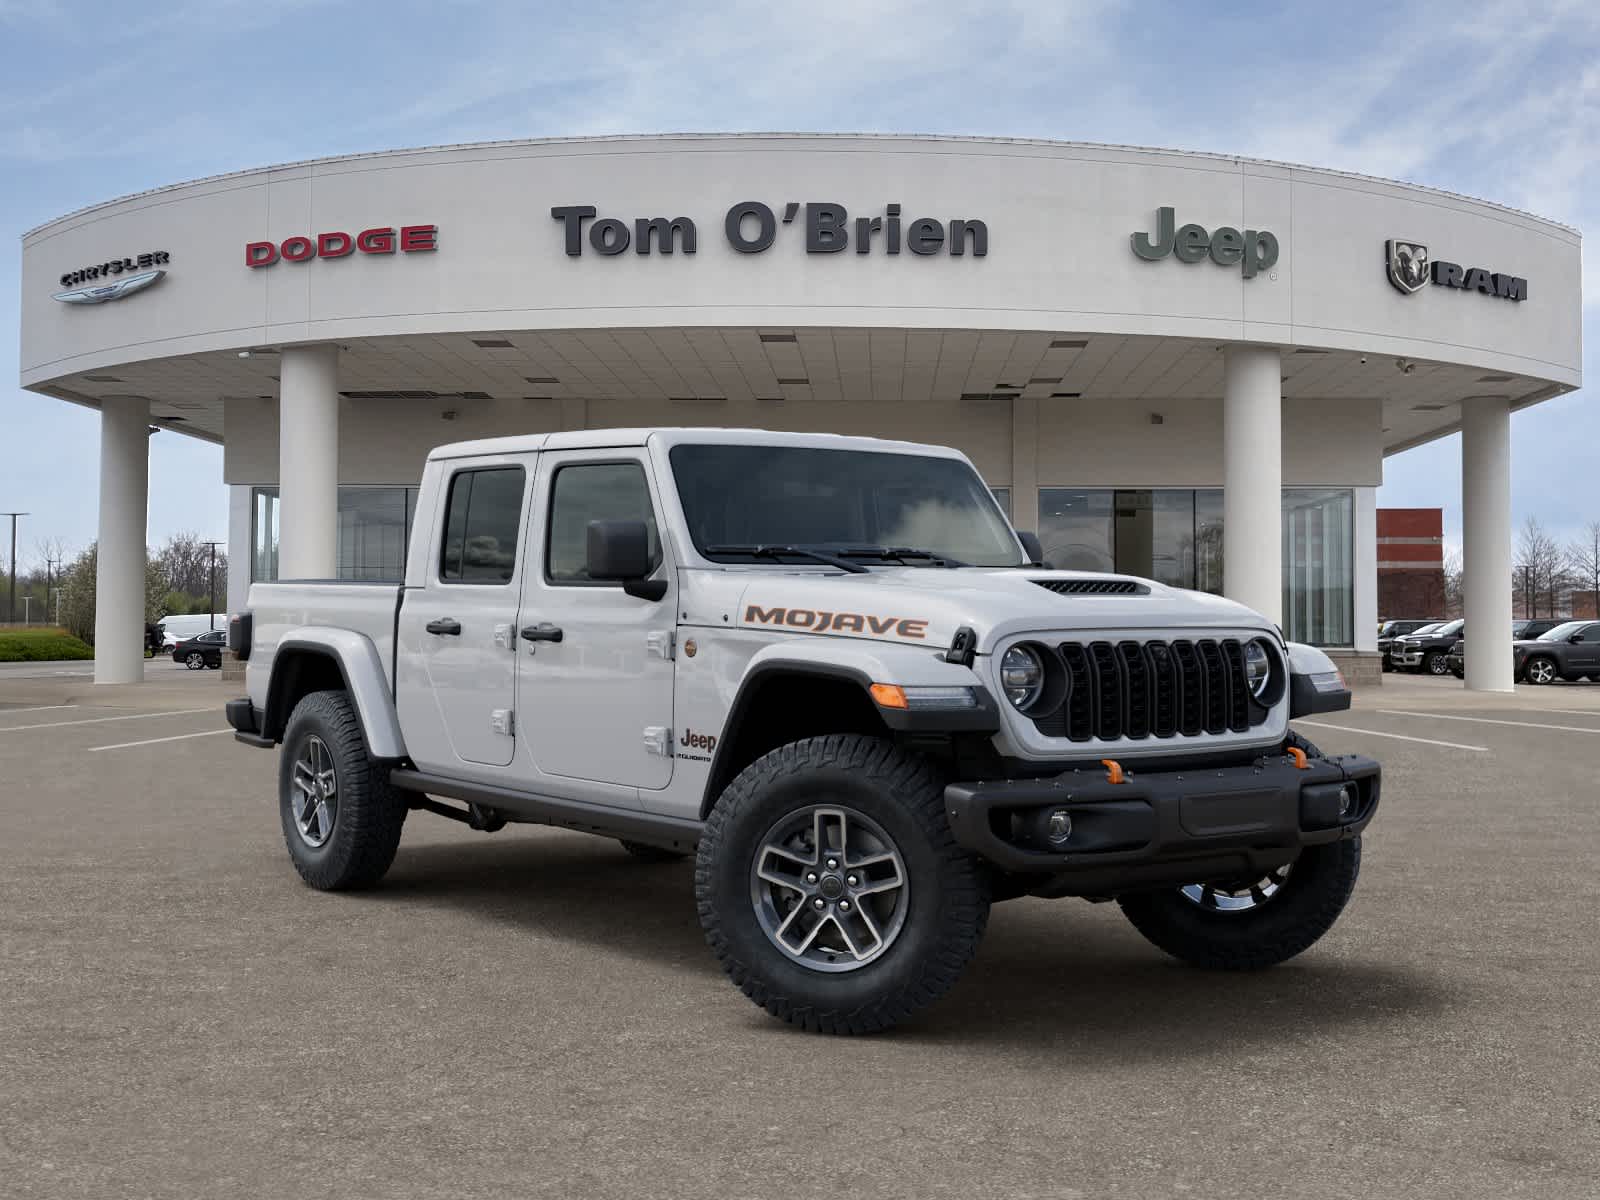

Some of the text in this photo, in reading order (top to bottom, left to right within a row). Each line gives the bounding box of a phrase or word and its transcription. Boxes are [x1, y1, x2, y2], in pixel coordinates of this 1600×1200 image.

[245, 224, 438, 269] DODGE
[551, 201, 988, 257] Tom O'Brien
[1130, 206, 1279, 279] Jeep
[60, 249, 170, 287] CHRYSLER
[1430, 261, 1528, 301] RAM
[744, 605, 929, 638] MOJAVE
[681, 728, 716, 753] Jeep
